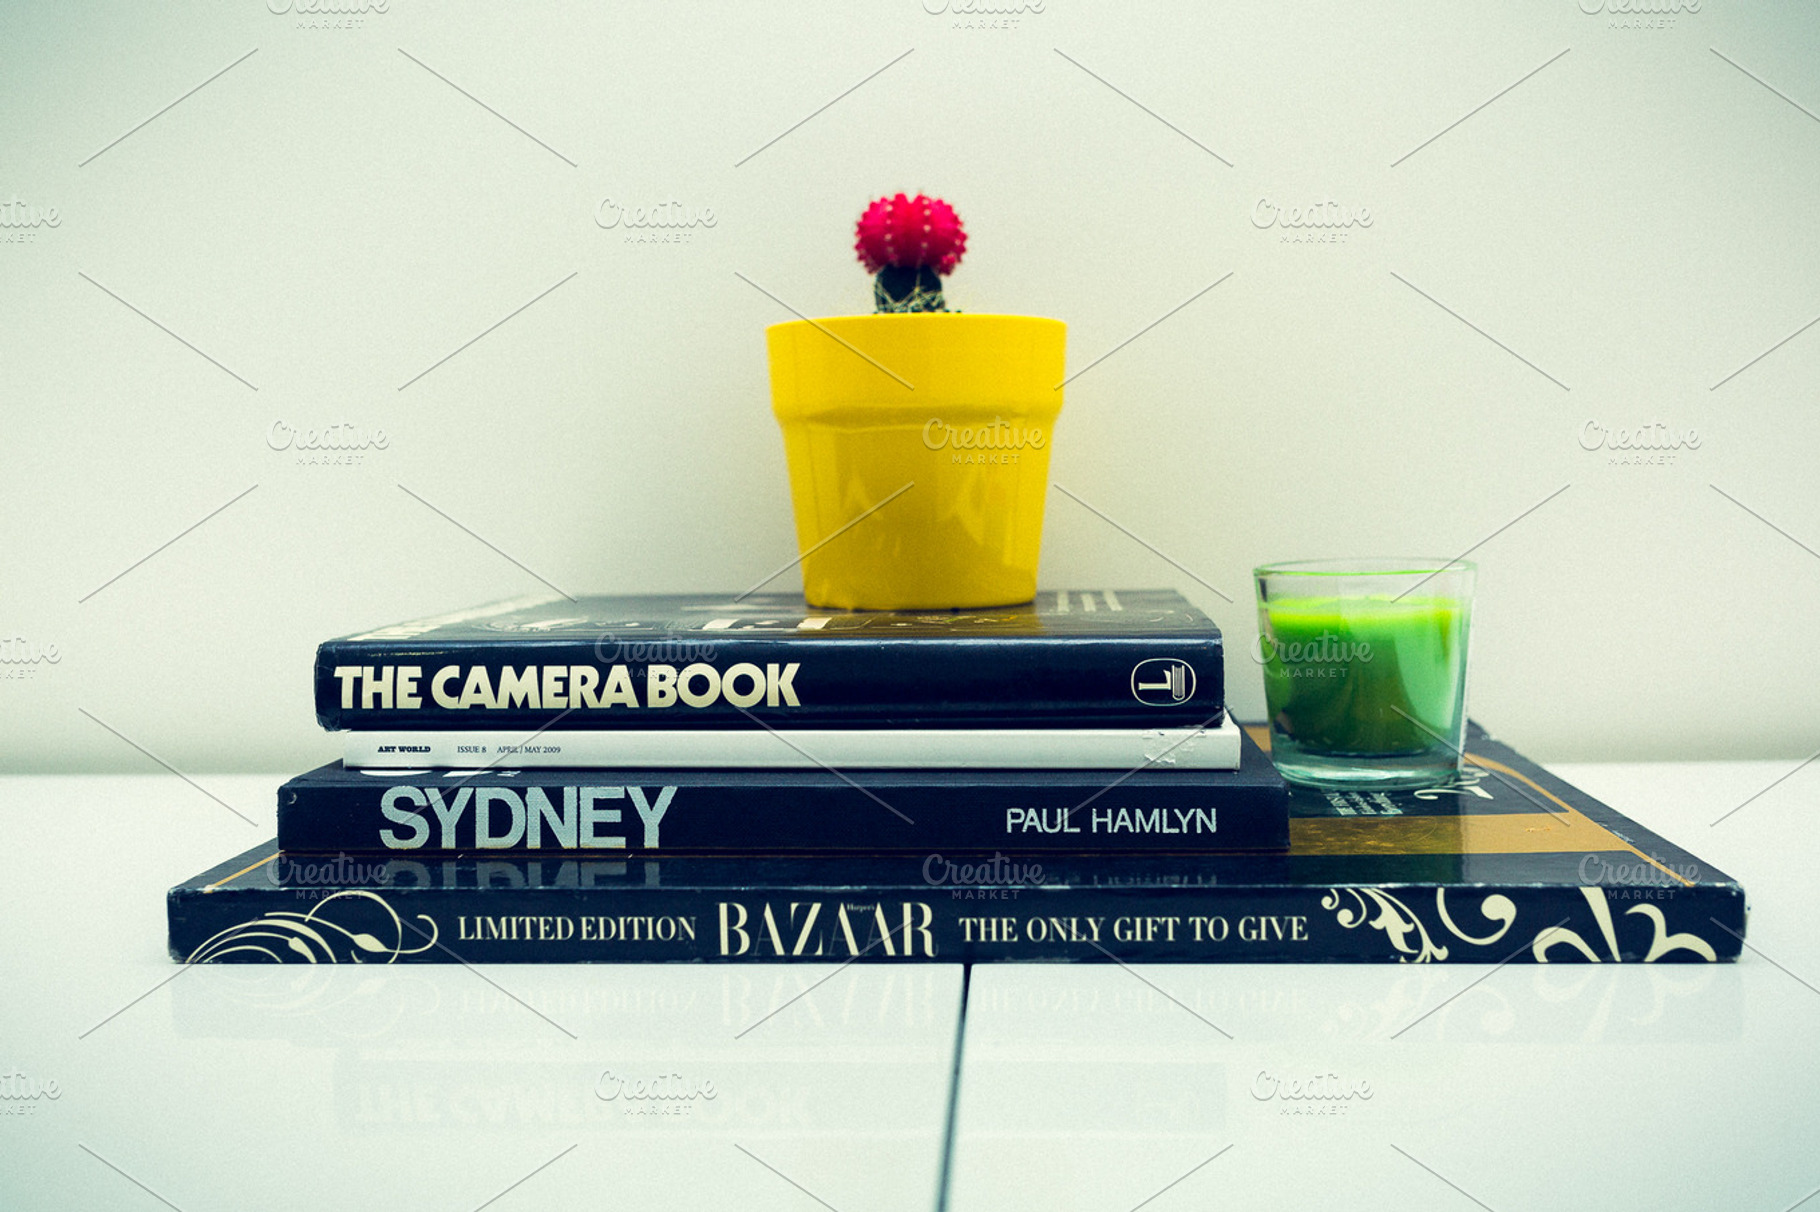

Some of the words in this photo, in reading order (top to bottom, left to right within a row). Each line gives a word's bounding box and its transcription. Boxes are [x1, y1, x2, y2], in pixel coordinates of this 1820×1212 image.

[334, 665, 423, 709] THE
[431, 663, 640, 709] CAMERA
[646, 662, 801, 708] BOOK
[377, 745, 396, 754] ART
[398, 745, 431, 754] WORLD
[457, 745, 480, 754] ISSUE
[524, 745, 541, 754] MAY
[543, 745, 561, 754] 2009
[379, 785, 678, 850] SYDNEY
[1006, 808, 1081, 834] PAUL
[1091, 808, 1217, 834] HAMLYN
[458, 916, 574, 941] LIMITED
[579, 916, 697, 941] EDITION
[717, 902, 940, 957] BAZAAR
[958, 917, 1019, 942] THE
[1026, 916, 1105, 942] ONLY
[1113, 916, 1181, 942] GIFT
[1188, 916, 1229, 942] TO
[1238, 916, 1309, 942] GIVE
